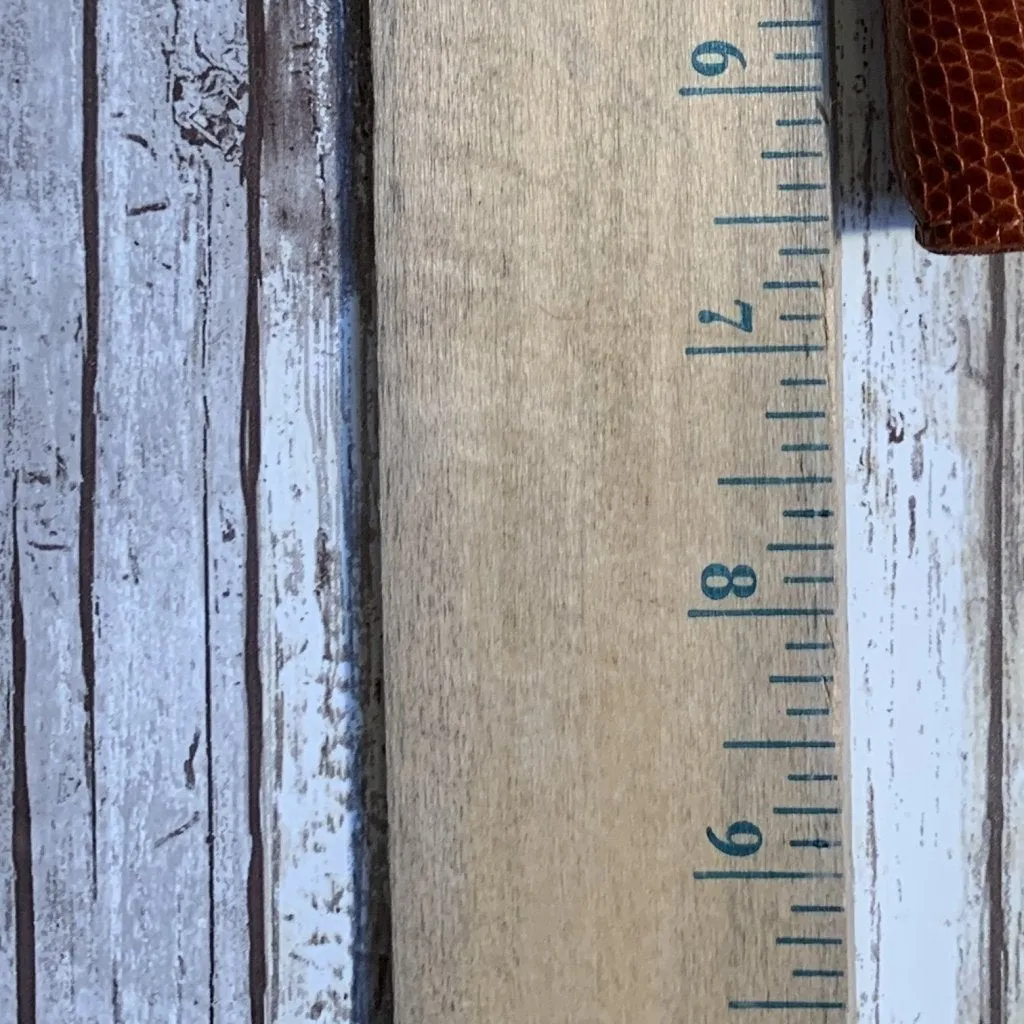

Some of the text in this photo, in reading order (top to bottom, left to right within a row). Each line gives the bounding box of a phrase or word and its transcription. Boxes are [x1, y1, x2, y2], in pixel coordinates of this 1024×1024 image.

[691, 41, 747, 77] 6
[699, 301, 754, 333] 7
[701, 563, 757, 601] 8
[706, 820, 763, 858] 9
